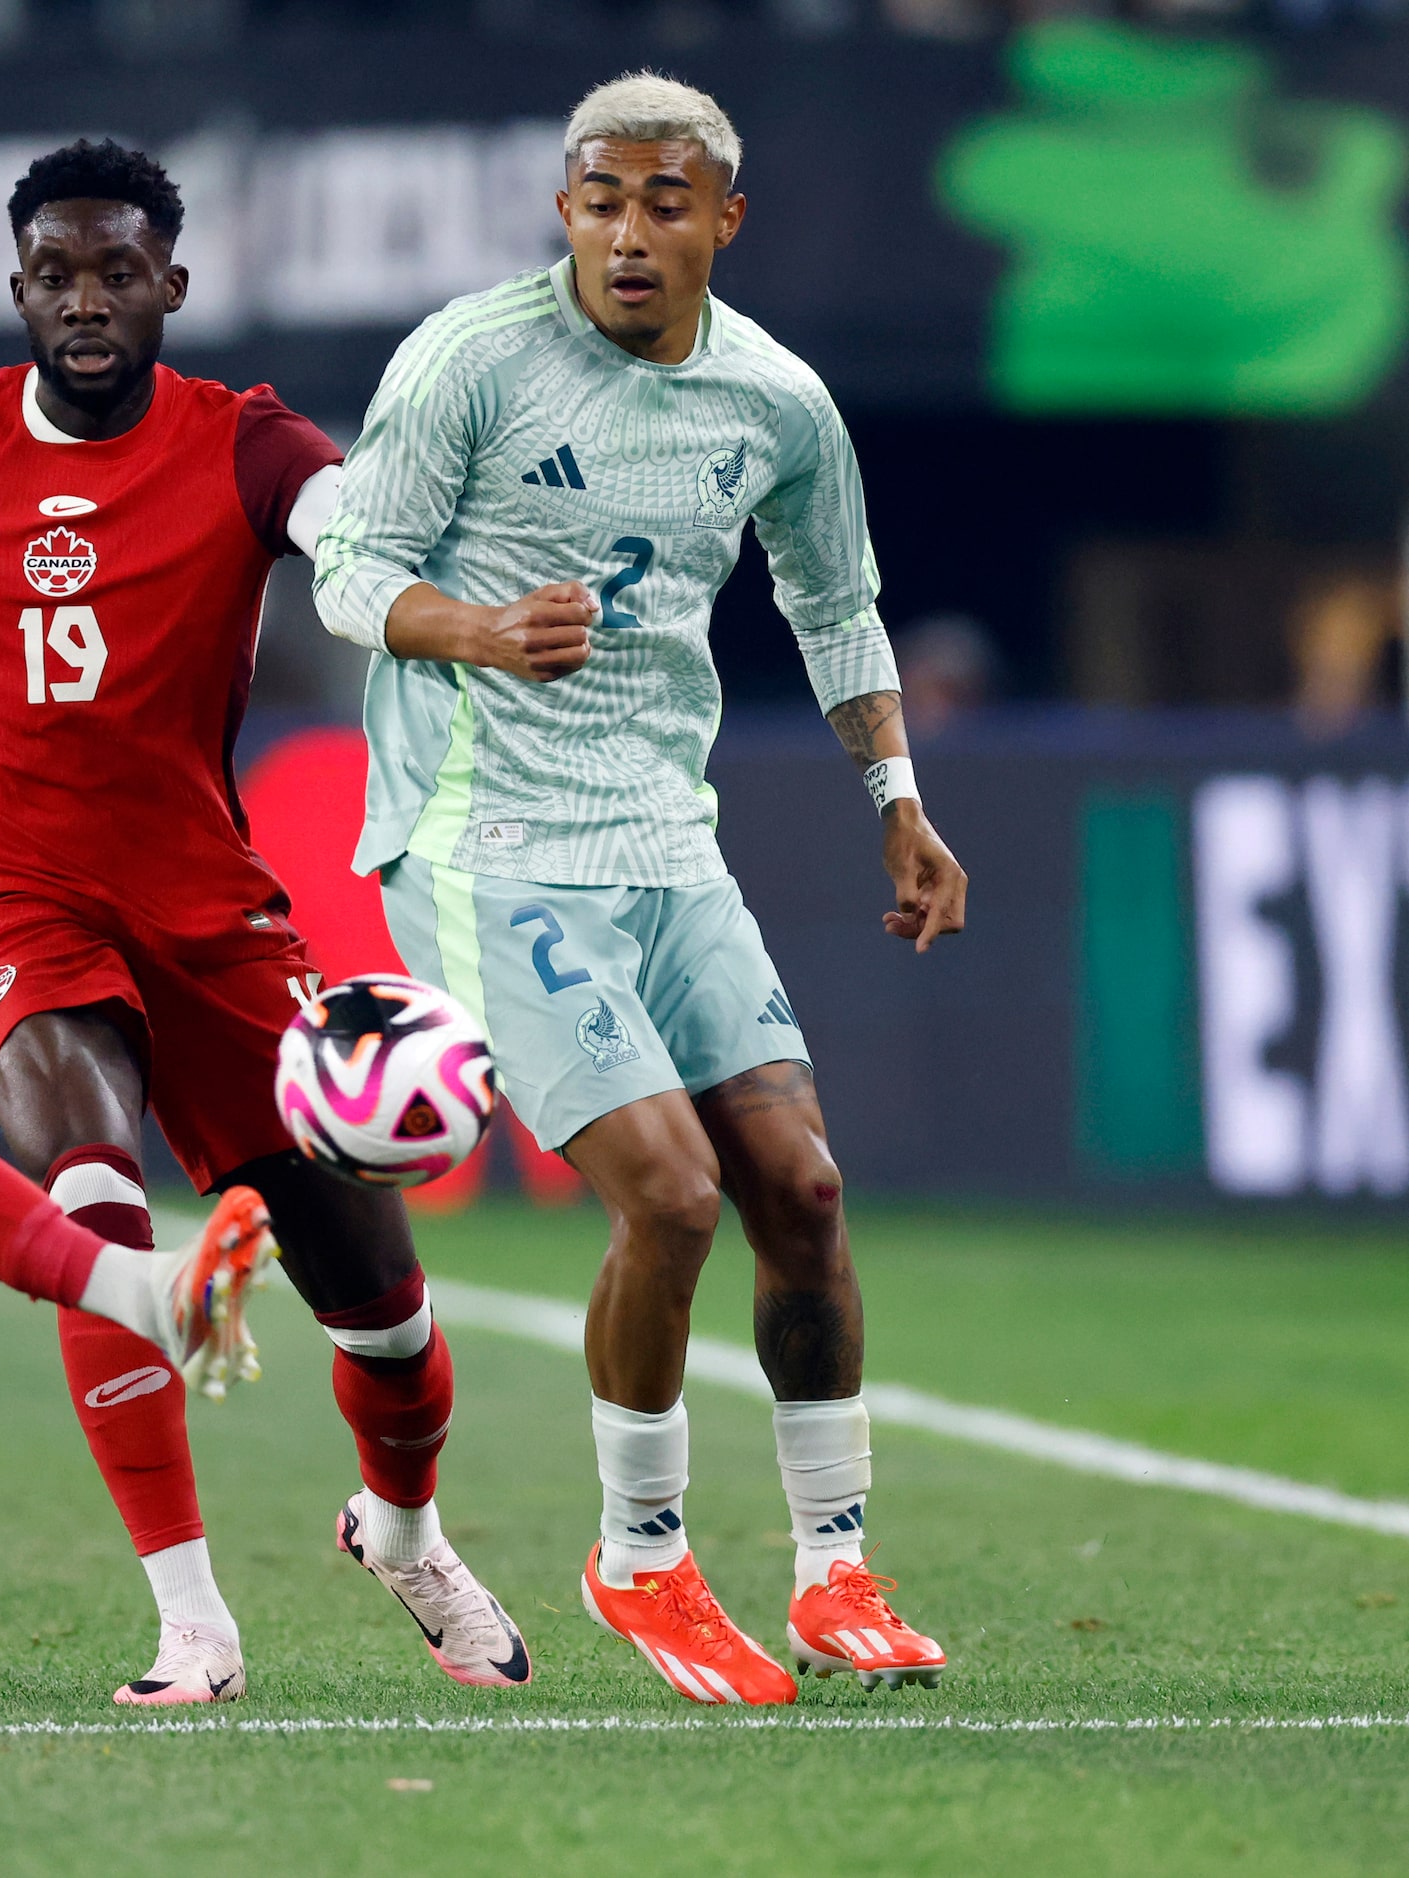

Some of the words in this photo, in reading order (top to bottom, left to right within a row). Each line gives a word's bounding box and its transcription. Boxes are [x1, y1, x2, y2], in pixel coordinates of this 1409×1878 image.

[26, 557, 92, 568] CANADA
[600, 536, 654, 628] 2
[18, 605, 109, 704] 19
[510, 903, 593, 995] 2
[1195, 772, 1409, 1196] EX
